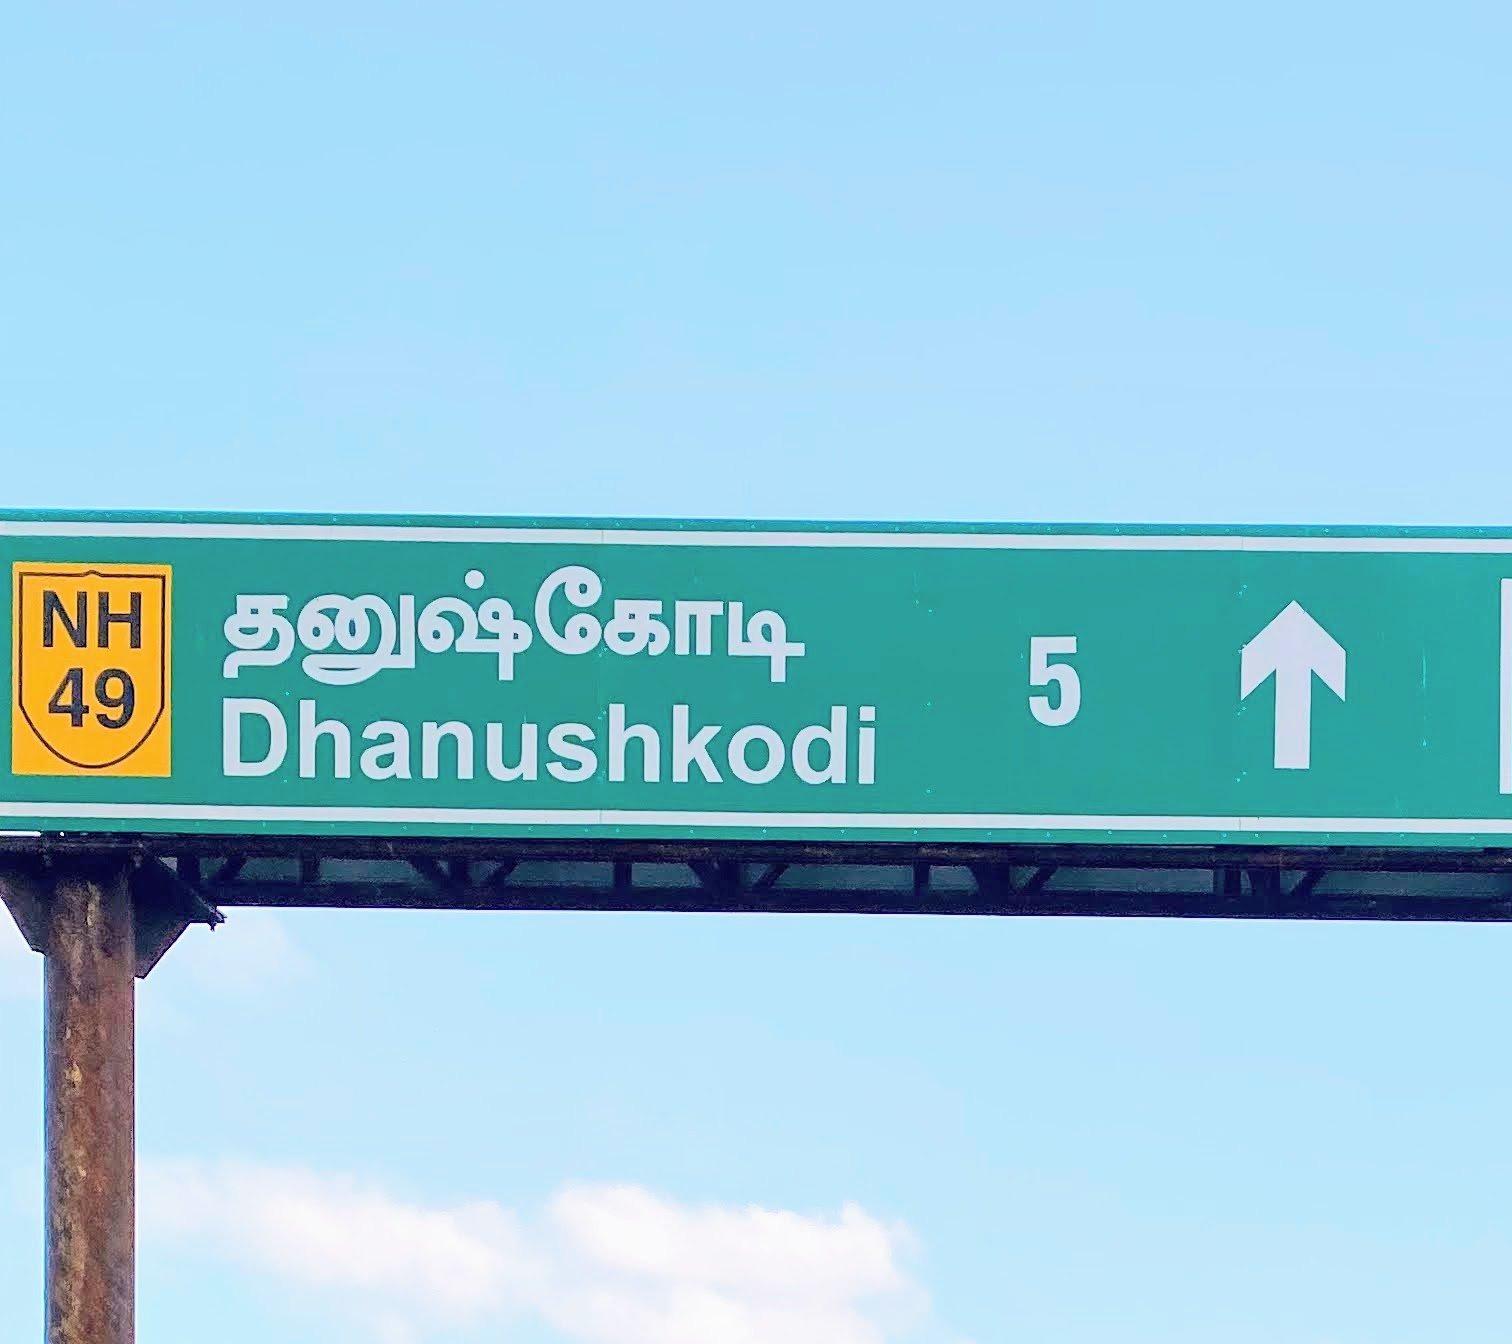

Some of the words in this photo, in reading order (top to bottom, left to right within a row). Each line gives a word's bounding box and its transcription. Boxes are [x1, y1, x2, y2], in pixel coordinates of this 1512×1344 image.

[43, 591, 142, 649] NH
[223, 566, 805, 685] தனுஷ்கோடி
[48, 667, 135, 730] 49
[1029, 636, 1081, 726] 5
[223, 698, 876, 784] Dhanushkodi
